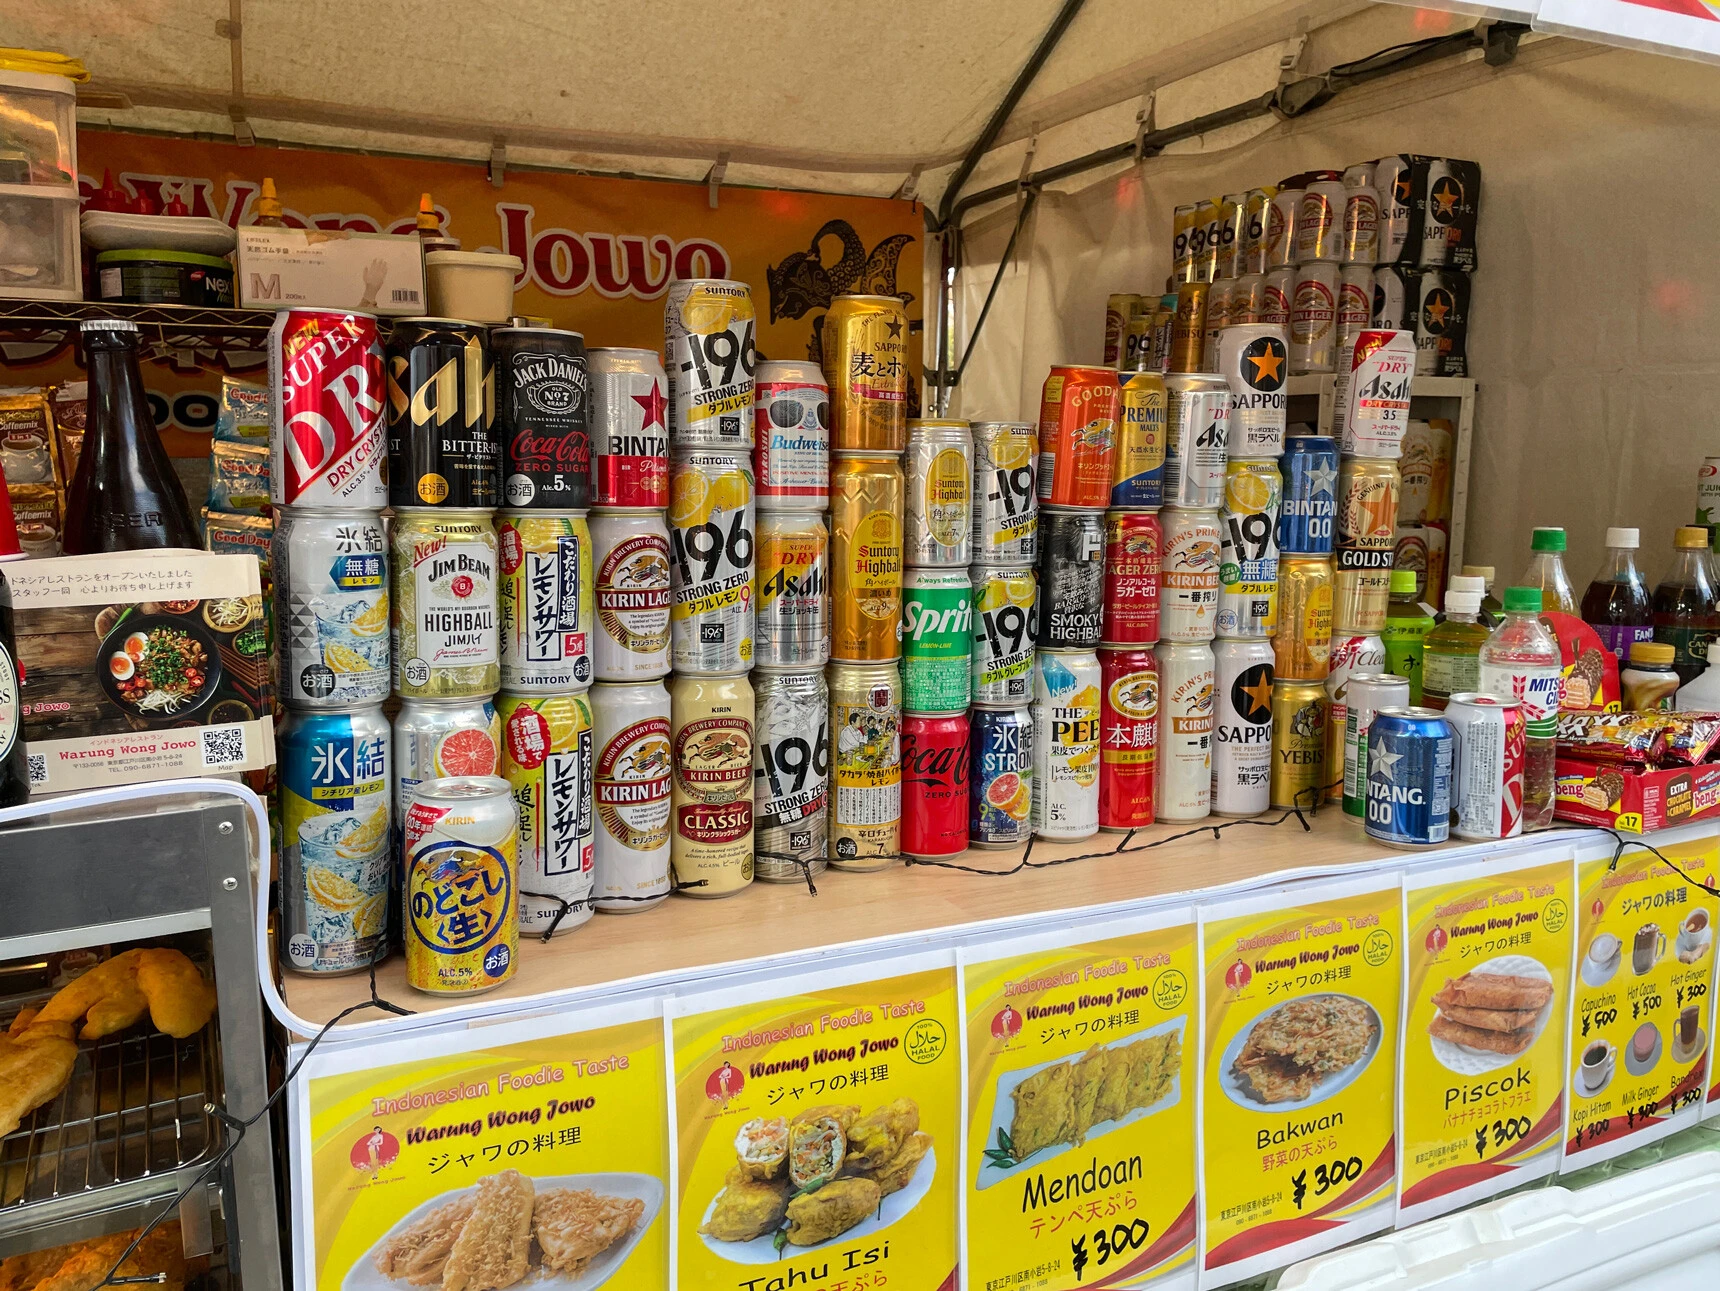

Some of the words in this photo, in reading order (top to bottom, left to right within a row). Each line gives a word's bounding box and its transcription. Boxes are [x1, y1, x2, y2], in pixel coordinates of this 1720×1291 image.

[496, 202, 731, 300] Jowo
[250, 273, 281, 299] M
[705, 287, 746, 298] SUNTORY
[1306, 312, 1332, 320] LAGER
[283, 315, 365, 405] SUPER
[1356, 337, 1383, 363] NEW
[513, 362, 547, 389] JACK
[1071, 386, 1113, 407] GOOD
[1135, 392, 1161, 406] The
[1383, 409, 1396, 421] 3.5
[472, 432, 487, 440] THE
[511, 429, 589, 462] Coca-Cola
[1247, 433, 1279, 443] 黒ラベル
[515, 463, 550, 472] ZERO
[556, 463, 589, 473] SUGAR
[690, 457, 734, 465] SUNTORY
[1308, 518, 1331, 538] 0.0
[214, 531, 245, 544] Good
[246, 534, 271, 549] Day
[336, 526, 382, 553] 氷結
[413, 536, 447, 563] New!
[858, 545, 900, 559] Suntory
[345, 559, 379, 576] 無糖
[428, 559, 455, 582] JIM
[458, 554, 490, 581] BEAM
[855, 558, 901, 577] Highball
[1241, 560, 1277, 581] 無糖
[560, 541, 577, 627] こだわり酒場
[677, 579, 723, 603] STRONG
[725, 570, 749, 590] ZERO
[763, 569, 827, 597] Asahi
[1117, 578, 1156, 586] ノンアルコール
[1167, 575, 1205, 586] KIRIN
[688, 599, 714, 614] ダブル
[716, 592, 738, 607] レモン
[1116, 587, 1156, 597] ラガーゼロ
[1179, 591, 1217, 603] 一番搾り
[532, 557, 555, 656] レモンサワー
[779, 606, 819, 615] 生ジョッキ缶
[425, 612, 493, 632] HIGHBALL
[1051, 614, 1098, 626] SMOKY
[987, 652, 1023, 671] STRONG
[302, 673, 333, 688] お酒
[520, 675, 571, 684] SUNTORY
[35, 702, 70, 712] Jowo
[1052, 707, 1082, 719] THE
[60, 747, 115, 761] Warung
[121, 743, 156, 756] Wong
[161, 739, 196, 750] Jowo
[311, 737, 385, 784] 氷結
[690, 771, 723, 781] KIRIN
[726, 769, 747, 779] BEER
[871, 778, 890, 786] レモン
[321, 784, 380, 797] シチリア産レモン
[601, 784, 650, 801] KIRIN
[1670, 781, 1688, 796] EXTRA
[445, 816, 476, 825] KIRIN
[552, 758, 577, 869] レモンサワー
[684, 811, 750, 830] CLASSIC
[778, 808, 802, 824] 無糖
[803, 800, 821, 815] DRY
[1050, 810, 1066, 820] 5%
[1369, 801, 1392, 824] 0.0
[1625, 815, 1638, 827] 17
[412, 869, 505, 920] のどごし
[1435, 897, 1489, 919] Indonesian
[1492, 890, 1524, 908] Foodie
[1527, 884, 1555, 898] Taste
[1236, 930, 1301, 953] Indonesian
[1304, 920, 1343, 939] Foodie
[1348, 913, 1380, 930] Taste
[1450, 921, 1485, 939] Warung
[1487, 915, 1513, 932] Wong
[1515, 911, 1539, 928] Jowo
[291, 942, 315, 957] お酒
[1367, 949, 1389, 959] HALAL
[1460, 931, 1532, 959] ジャワの料理
[485, 950, 509, 969] お酒
[1254, 954, 1297, 974] Warung
[1299, 947, 1329, 966] Wong
[1332, 942, 1360, 961] Jowo
[1003, 970, 1080, 998] Indonesian
[1083, 961, 1128, 981] Foodie
[1134, 953, 1171, 973] Taste
[1266, 965, 1352, 995] ジャワの料理
[1670, 972, 1683, 987] Hot
[1684, 968, 1707, 984] Ginger
[1156, 981, 1183, 996] حلال
[1158, 993, 1182, 1003] HALAL
[1626, 986, 1638, 1000] Hot
[1639, 982, 1657, 998] Cocoa
[1026, 999, 1075, 1021] Warung
[1078, 991, 1114, 1010] Wong
[1116, 984, 1149, 1003] Jowo
[1581, 992, 1617, 1012] Capuchino
[1632, 994, 1662, 1019] ¥500
[722, 1022, 813, 1053] Indonesian
[820, 1008, 873, 1034] Foodie
[880, 999, 926, 1020] Taste
[1040, 1009, 1140, 1045] ジャワの料理
[1581, 1008, 1618, 1037] ¥500
[749, 1055, 810, 1080] Warung
[812, 1045, 856, 1065] Wong
[860, 1035, 899, 1058] Jowo
[911, 1046, 941, 1057] HALAL
[371, 1081, 490, 1118] Indonesian
[498, 1066, 564, 1094] Foodie
[572, 1053, 629, 1078] Taste
[767, 1063, 889, 1106] ジャワの料理
[1445, 1067, 1531, 1110] Piscok
[1622, 1089, 1637, 1106] Milk
[1638, 1084, 1660, 1103] Ginger
[406, 1119, 482, 1146] Warung
[488, 1105, 541, 1132] Wong
[547, 1096, 596, 1124] Jowo
[1573, 1108, 1588, 1123] Kopi
[1590, 1100, 1612, 1118] Hitam
[1256, 1111, 1344, 1150] Bakwan
[1475, 1115, 1532, 1159] ¥300
[428, 1126, 583, 1175] ジャワの料理
[1262, 1135, 1339, 1172] 野菜の天ぷら
[1021, 1155, 1143, 1213] Mendoan
[1291, 1156, 1363, 1210] ¥300
[1029, 1190, 1138, 1239] テンペ天ぷら
[1071, 1218, 1149, 1282] ¥300
[738, 1263, 829, 1291] Tahu
[842, 1240, 890, 1271] Isi
